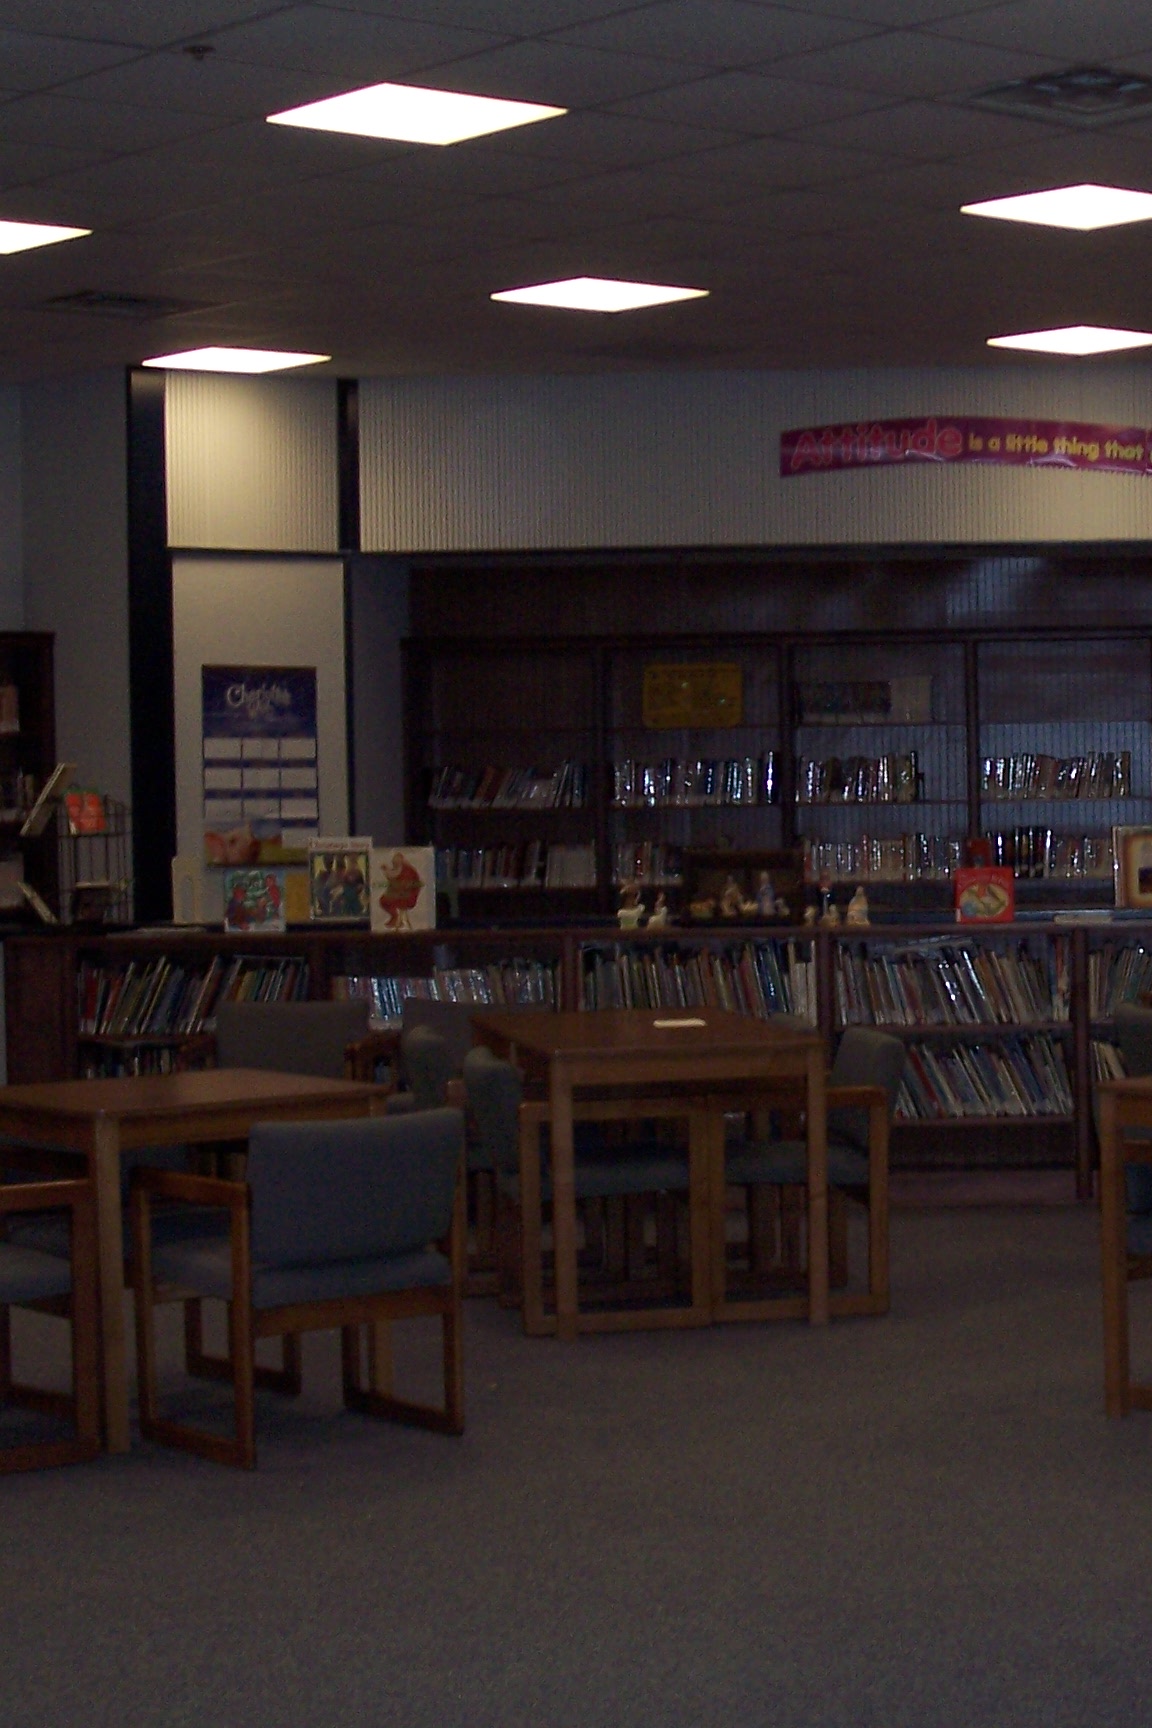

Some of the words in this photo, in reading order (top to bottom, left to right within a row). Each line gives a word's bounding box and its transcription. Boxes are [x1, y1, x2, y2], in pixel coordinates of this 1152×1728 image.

[791, 417, 962, 469] Attitude
[968, 433, 984, 451] is
[988, 437, 1002, 452] a
[1005, 433, 1050, 454] little
[1053, 436, 1101, 462] thing
[1104, 439, 1145, 461] that
